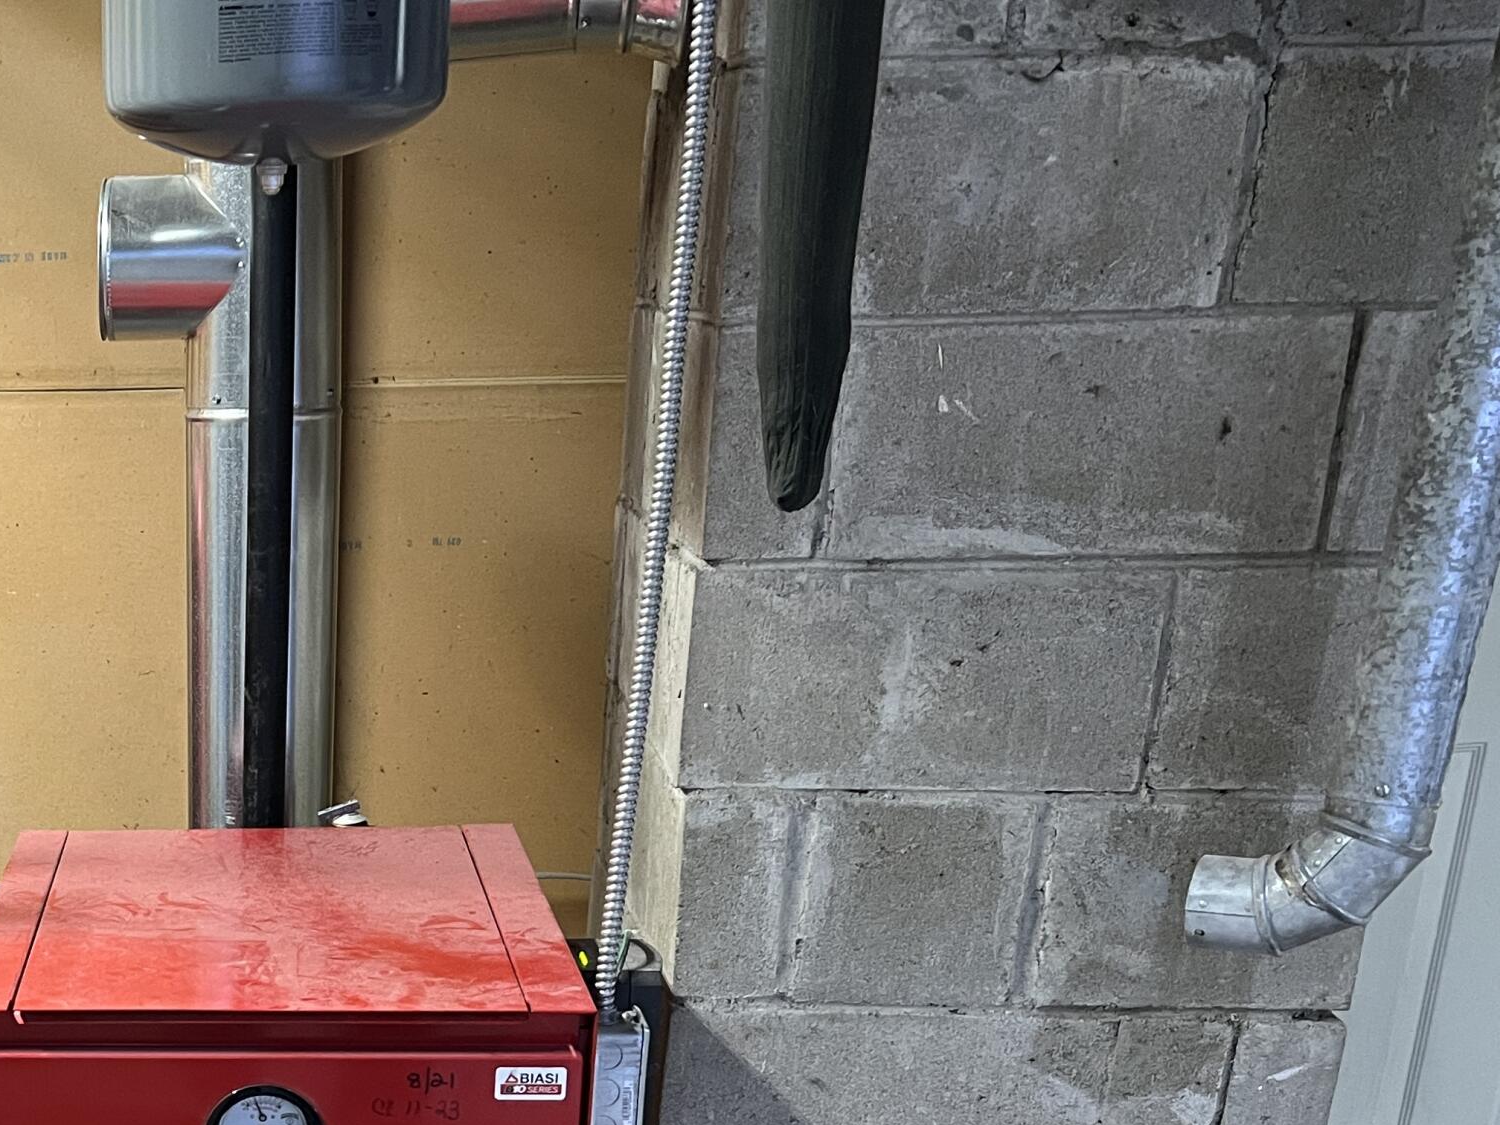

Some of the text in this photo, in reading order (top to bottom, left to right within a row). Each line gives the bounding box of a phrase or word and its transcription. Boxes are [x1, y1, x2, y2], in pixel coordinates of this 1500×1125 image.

[407, 1066, 455, 1095] 8/21
[520, 1072, 559, 1084] BIASI
[526, 1085, 559, 1094] SERIES
